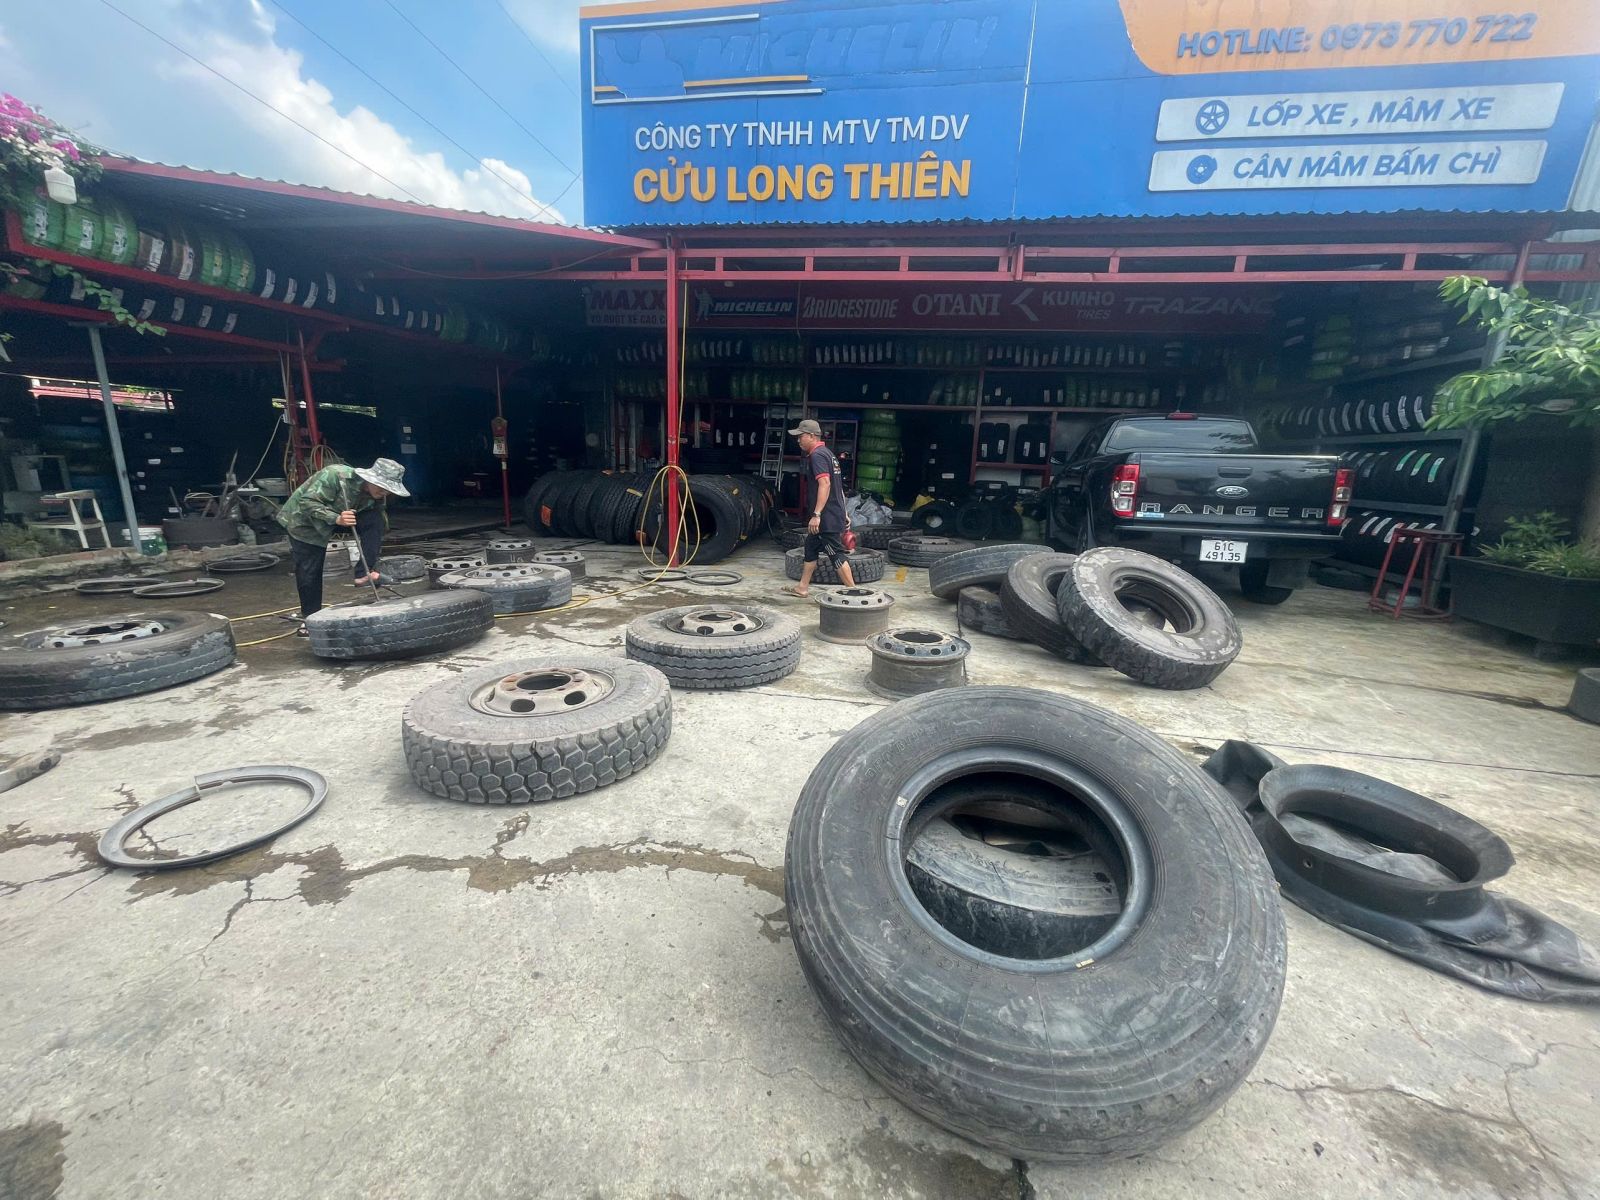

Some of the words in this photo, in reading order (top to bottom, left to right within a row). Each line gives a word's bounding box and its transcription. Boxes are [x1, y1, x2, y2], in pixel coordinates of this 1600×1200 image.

[1177, 26, 1314, 58] HOTLINE:
[1320, 20, 1402, 51] 0973
[1404, 16, 1469, 49] 770
[1472, 12, 1538, 44] 722
[1247, 98, 1304, 127] LỐP
[1304, 102, 1349, 125] XE
[1367, 96, 1445, 123] MÂM
[1448, 97, 1496, 121] XE
[634, 121, 702, 151] CÔNG
[705, 123, 738, 148] TY
[742, 120, 813, 147] TNHH
[822, 118, 881, 145] MTV
[886, 115, 925, 143] TM
[930, 114, 969, 141] DV
[1233, 152, 1293, 179] CÂN
[1298, 150, 1370, 178] MÂM
[1372, 146, 1441, 176] BẤM
[1448, 146, 1502, 174] CHÌ
[633, 156, 716, 203] CỬU
[727, 163, 834, 201] LONG
[843, 150, 972, 200] THIÊN
[588, 287, 667, 311] MAXX
[714, 301, 794, 313] MICHELIN
[802, 296, 900, 320] BRIDGESTONE
[912, 293, 1002, 317] OTANI
[1041, 291, 1116, 306] KUMHO
[1074, 308, 1112, 320] TIRES
[1140, 502, 1324, 519] RANGER
[1205, 551, 1242, 562] 491.35
[1214, 541, 1235, 551] 61C
